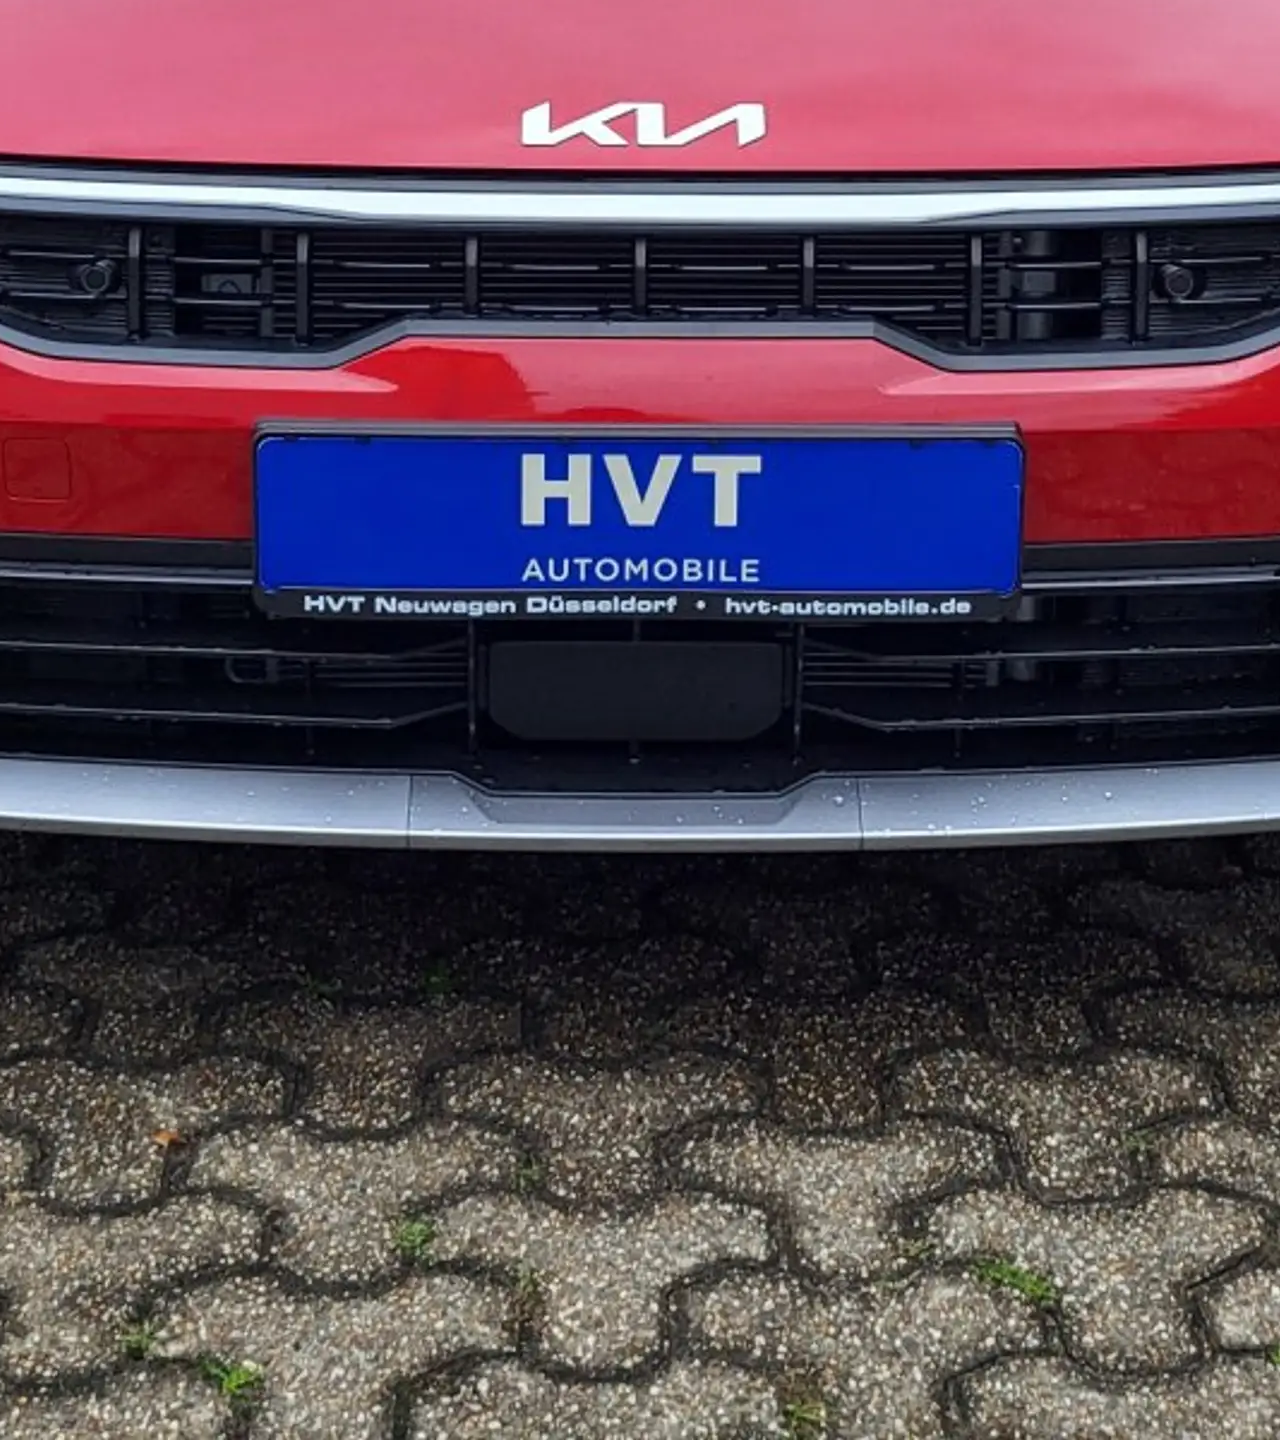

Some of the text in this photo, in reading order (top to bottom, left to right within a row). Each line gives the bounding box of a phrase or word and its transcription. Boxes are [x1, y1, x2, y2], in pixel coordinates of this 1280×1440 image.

[521, 100, 767, 148] KIA
[521, 453, 762, 527] HVT
[522, 558, 761, 582] AUTOMOBILE
[304, 595, 972, 617] HVT Neuwagen Düsseldorf hvt-automobile.de
